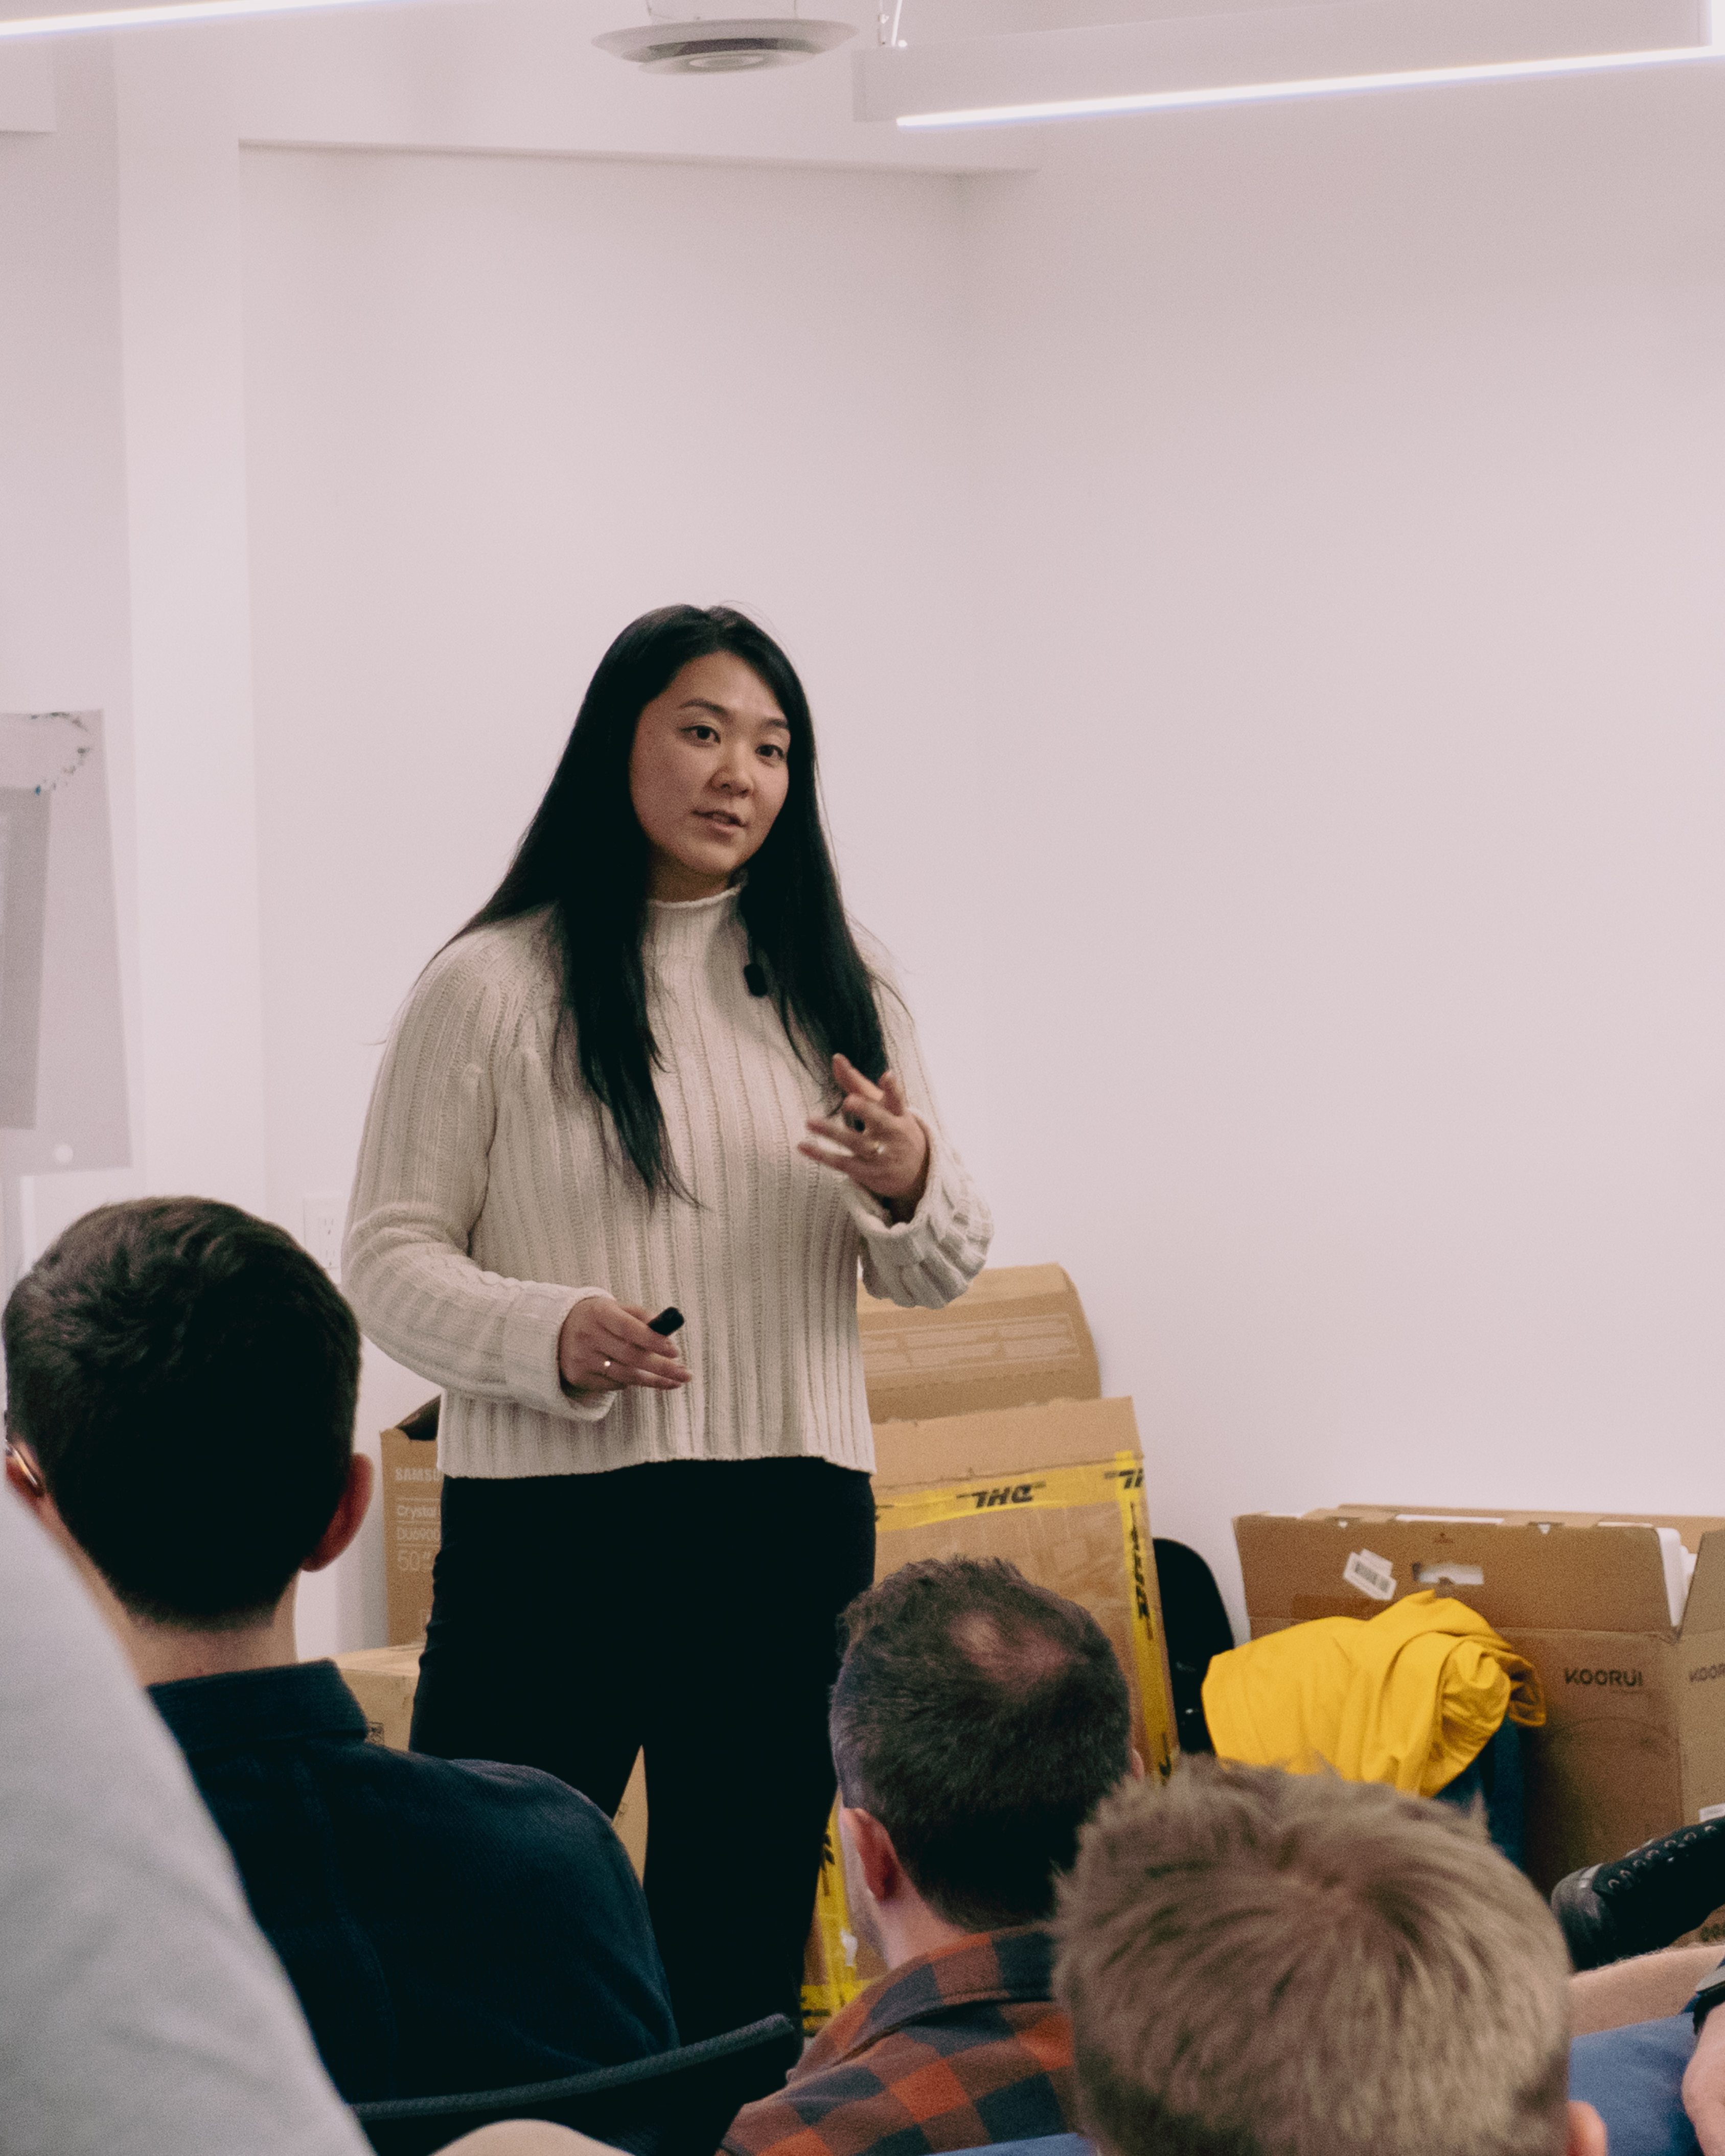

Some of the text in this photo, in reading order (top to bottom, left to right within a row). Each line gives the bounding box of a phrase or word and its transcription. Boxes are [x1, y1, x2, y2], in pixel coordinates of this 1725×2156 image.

[396, 1468, 442, 1481] SAMSU
[966, 1482, 1038, 1509] DHL
[1565, 1667, 1643, 1687] KOORUI
[1689, 1663, 1725, 1683] KOOR
